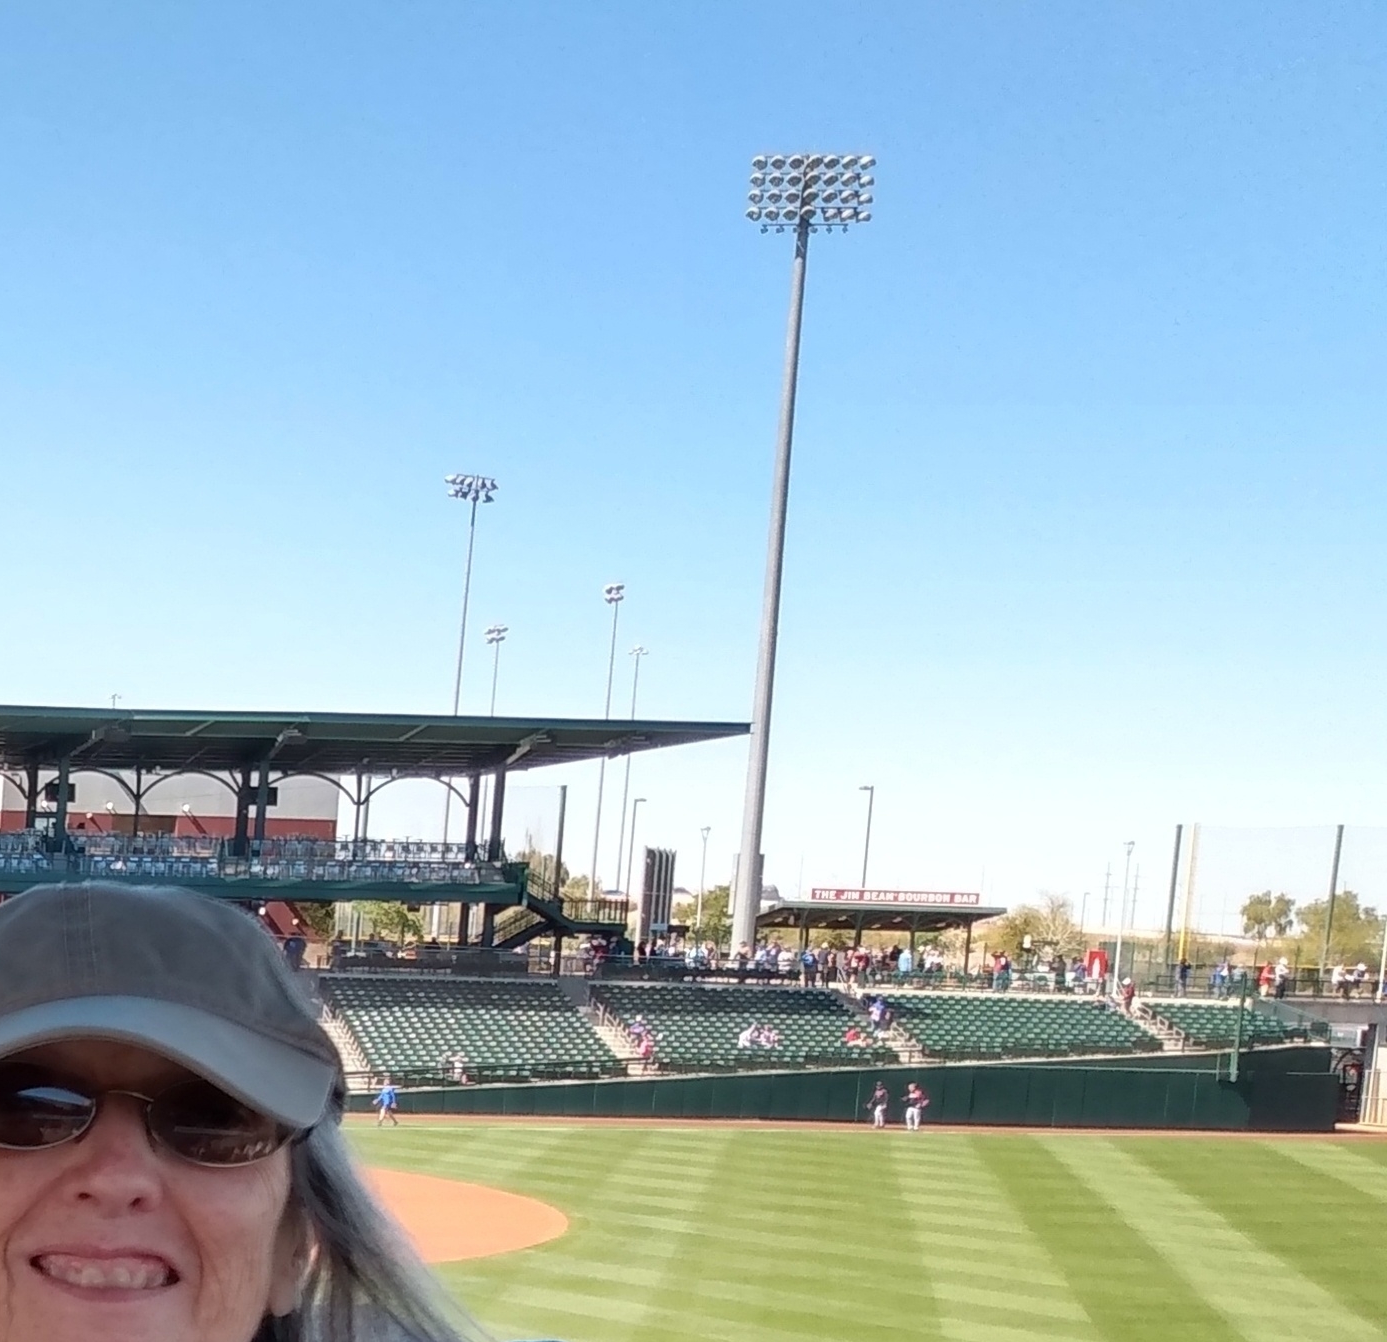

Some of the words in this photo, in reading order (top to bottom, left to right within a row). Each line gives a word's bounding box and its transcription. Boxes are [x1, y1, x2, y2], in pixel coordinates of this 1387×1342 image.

[814, 890, 837, 900] THE
[898, 892, 951, 903] BOURBON
[954, 894, 977, 904] BAR
